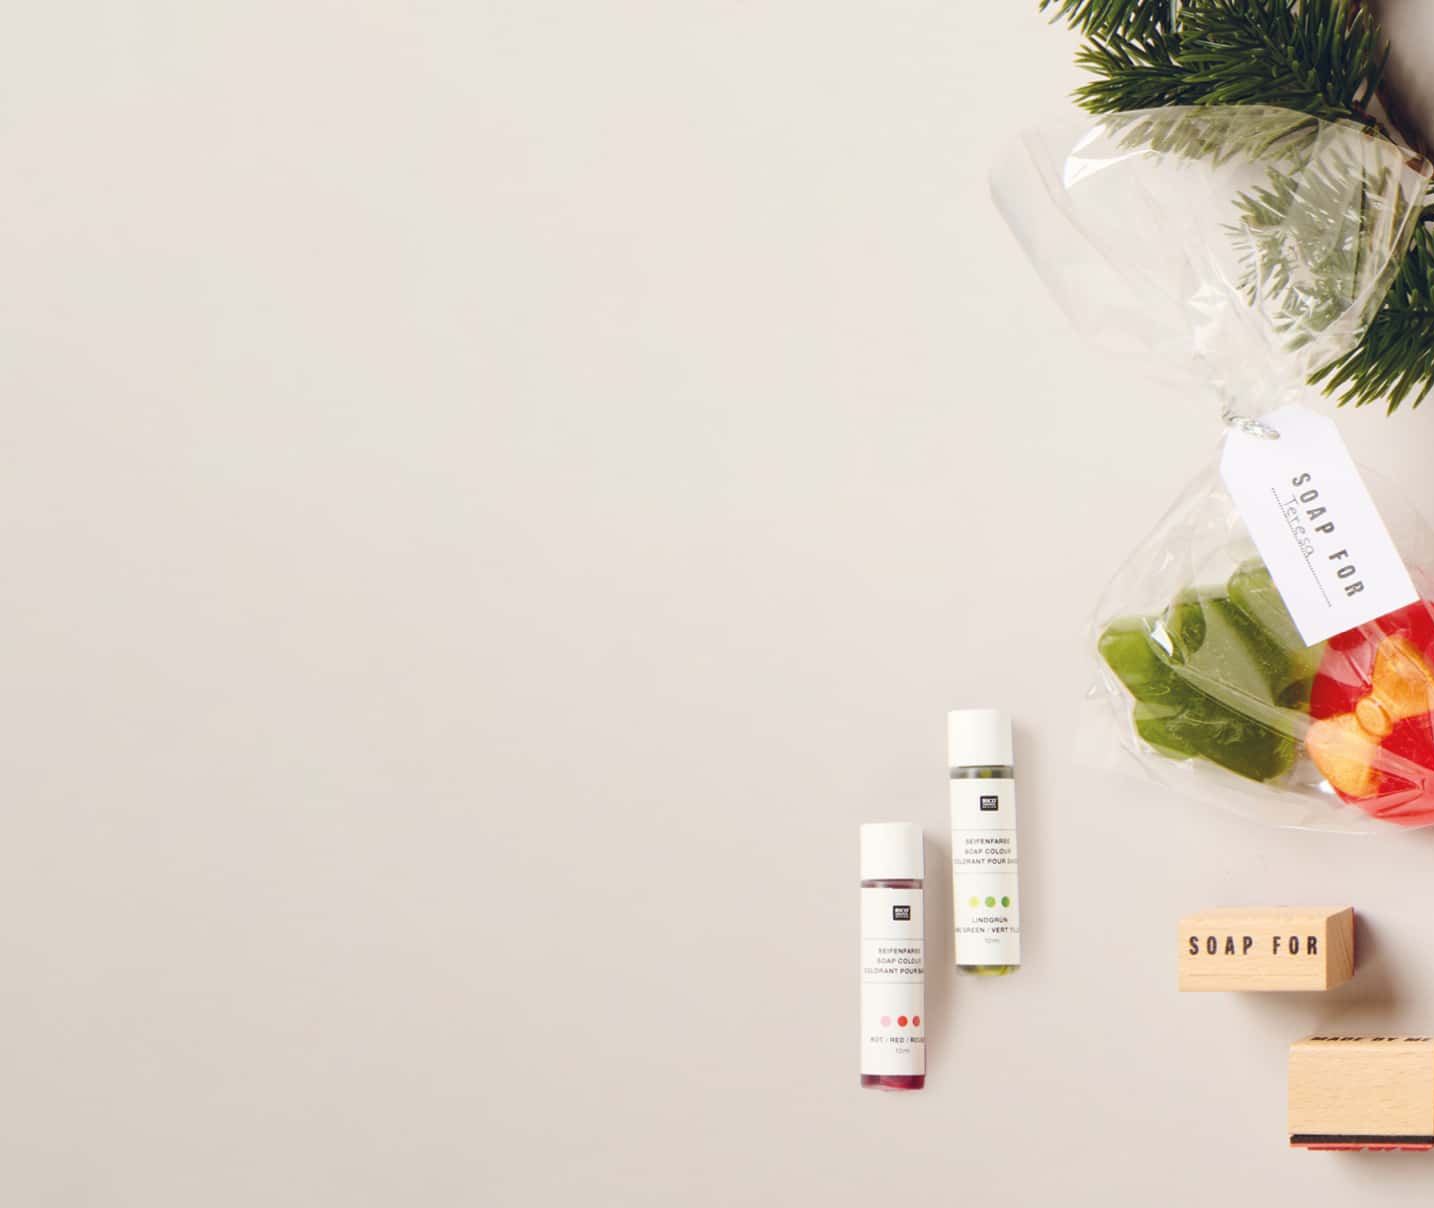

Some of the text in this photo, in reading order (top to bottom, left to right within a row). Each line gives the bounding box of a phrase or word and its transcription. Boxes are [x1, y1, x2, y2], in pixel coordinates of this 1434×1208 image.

[1283, 494, 1316, 559] Teresa
[1291, 472, 1365, 598] SOAP FOR
[1189, 935, 1318, 956] SOAP FOR
